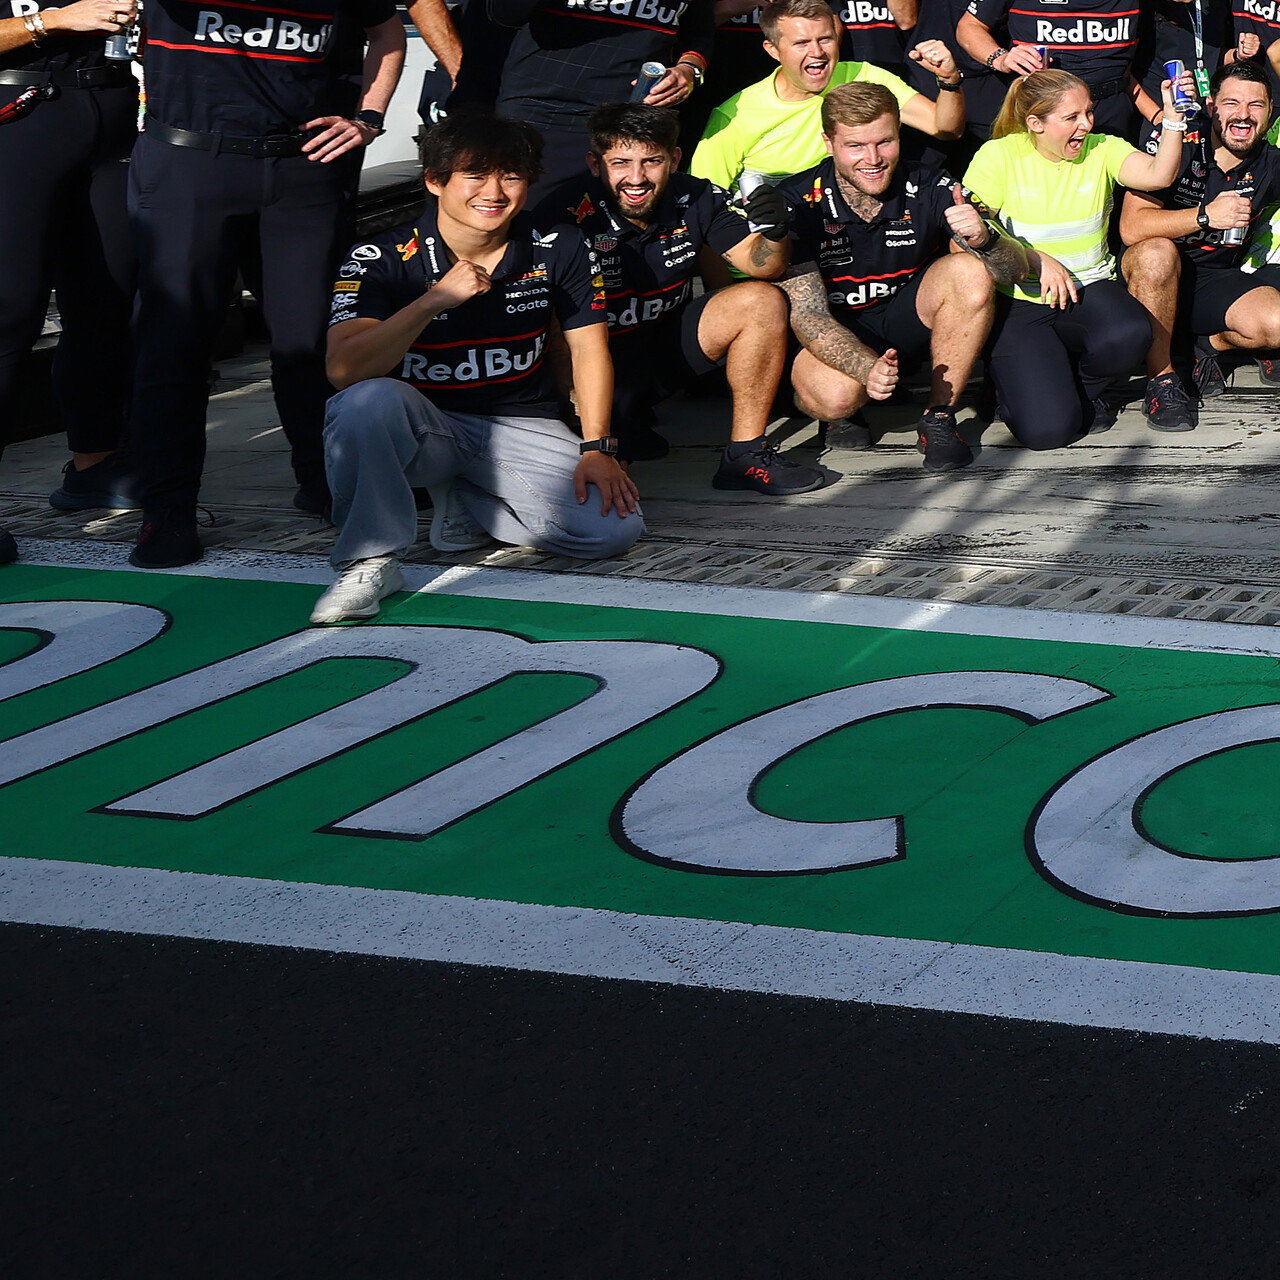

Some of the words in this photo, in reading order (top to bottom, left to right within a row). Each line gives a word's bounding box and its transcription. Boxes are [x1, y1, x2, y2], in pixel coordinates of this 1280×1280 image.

[194, 10, 274, 48] Red
[1037, 19, 1083, 42] Red
[1086, 18, 1130, 42] Bull
[819, 247, 851, 258] ORACLE
[820, 238, 843, 250] Mobil
[505, 286, 549, 299] HONDA
[828, 284, 866, 305] ed
[607, 297, 638, 328] ed
[401, 349, 480, 382] Red
